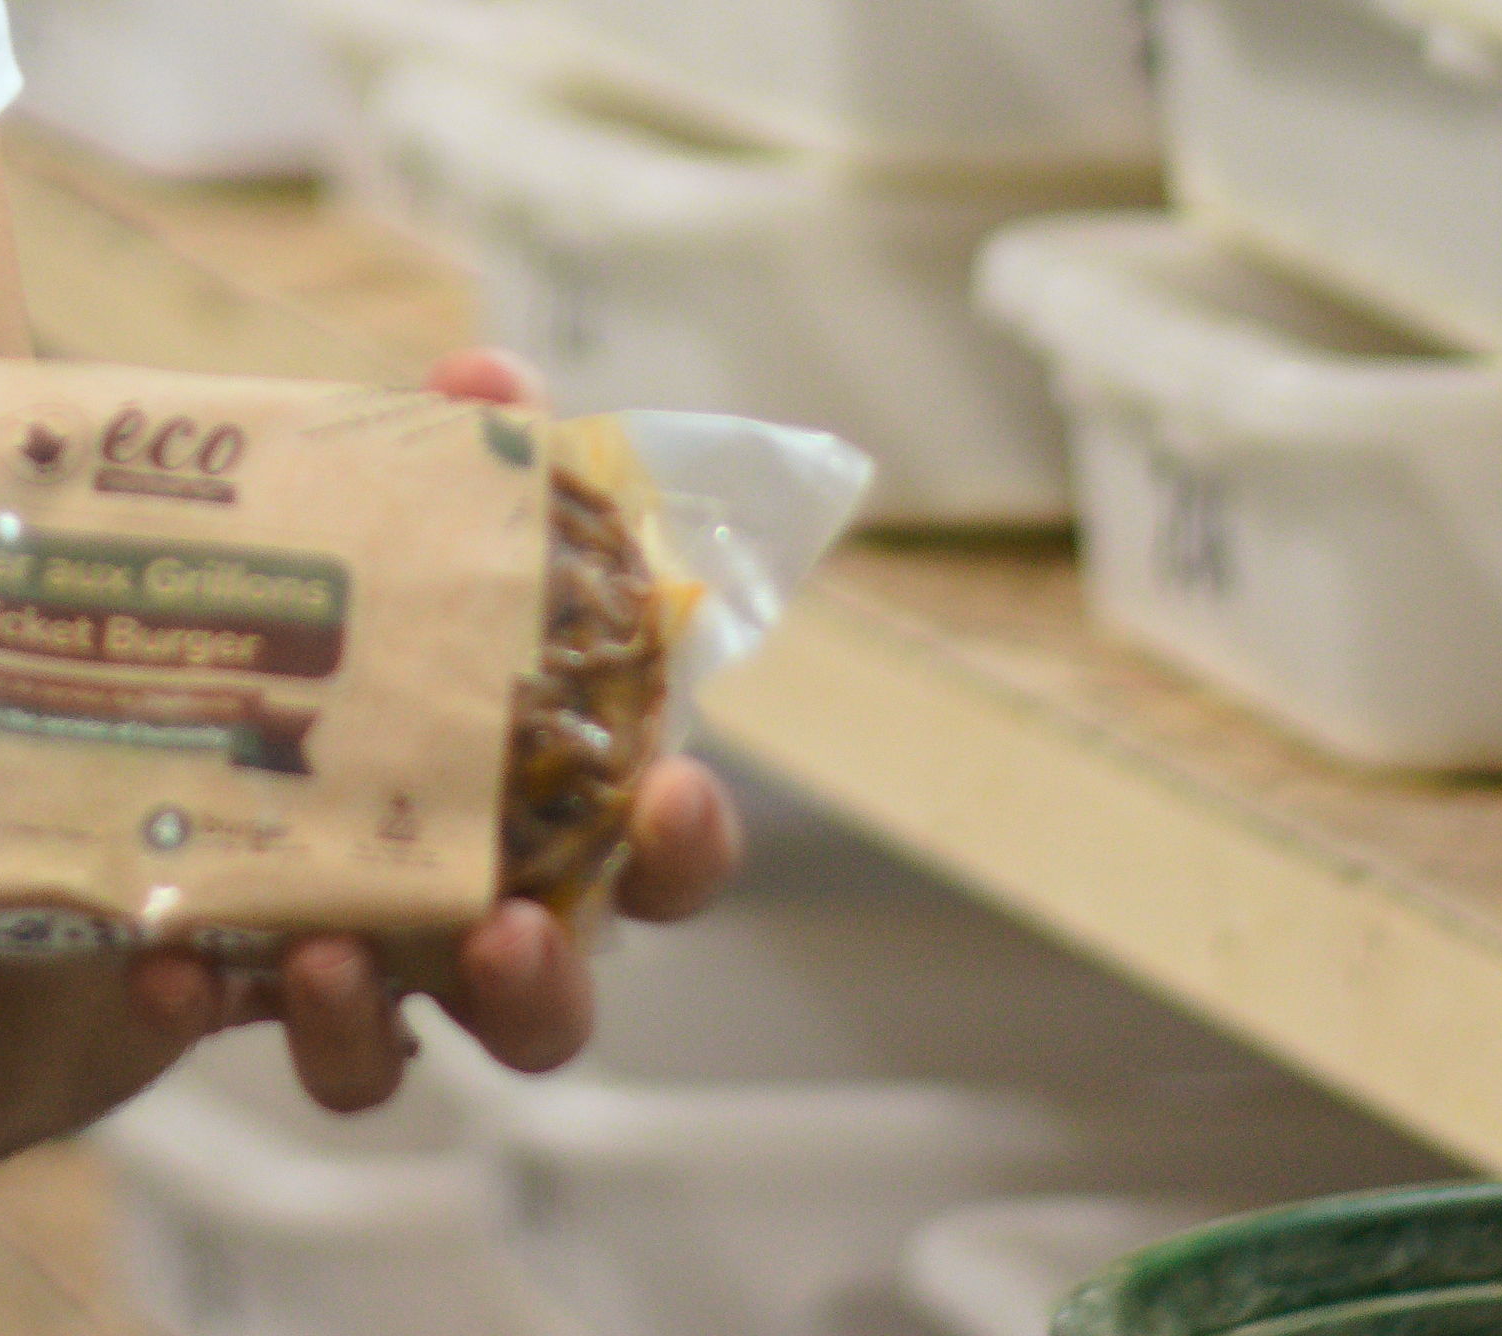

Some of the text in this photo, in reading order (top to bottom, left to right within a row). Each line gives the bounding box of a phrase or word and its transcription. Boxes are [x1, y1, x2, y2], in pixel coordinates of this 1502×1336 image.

[41, 558, 133, 595] aux
[143, 557, 332, 615] Grillons
[104, 613, 263, 666] Burger
